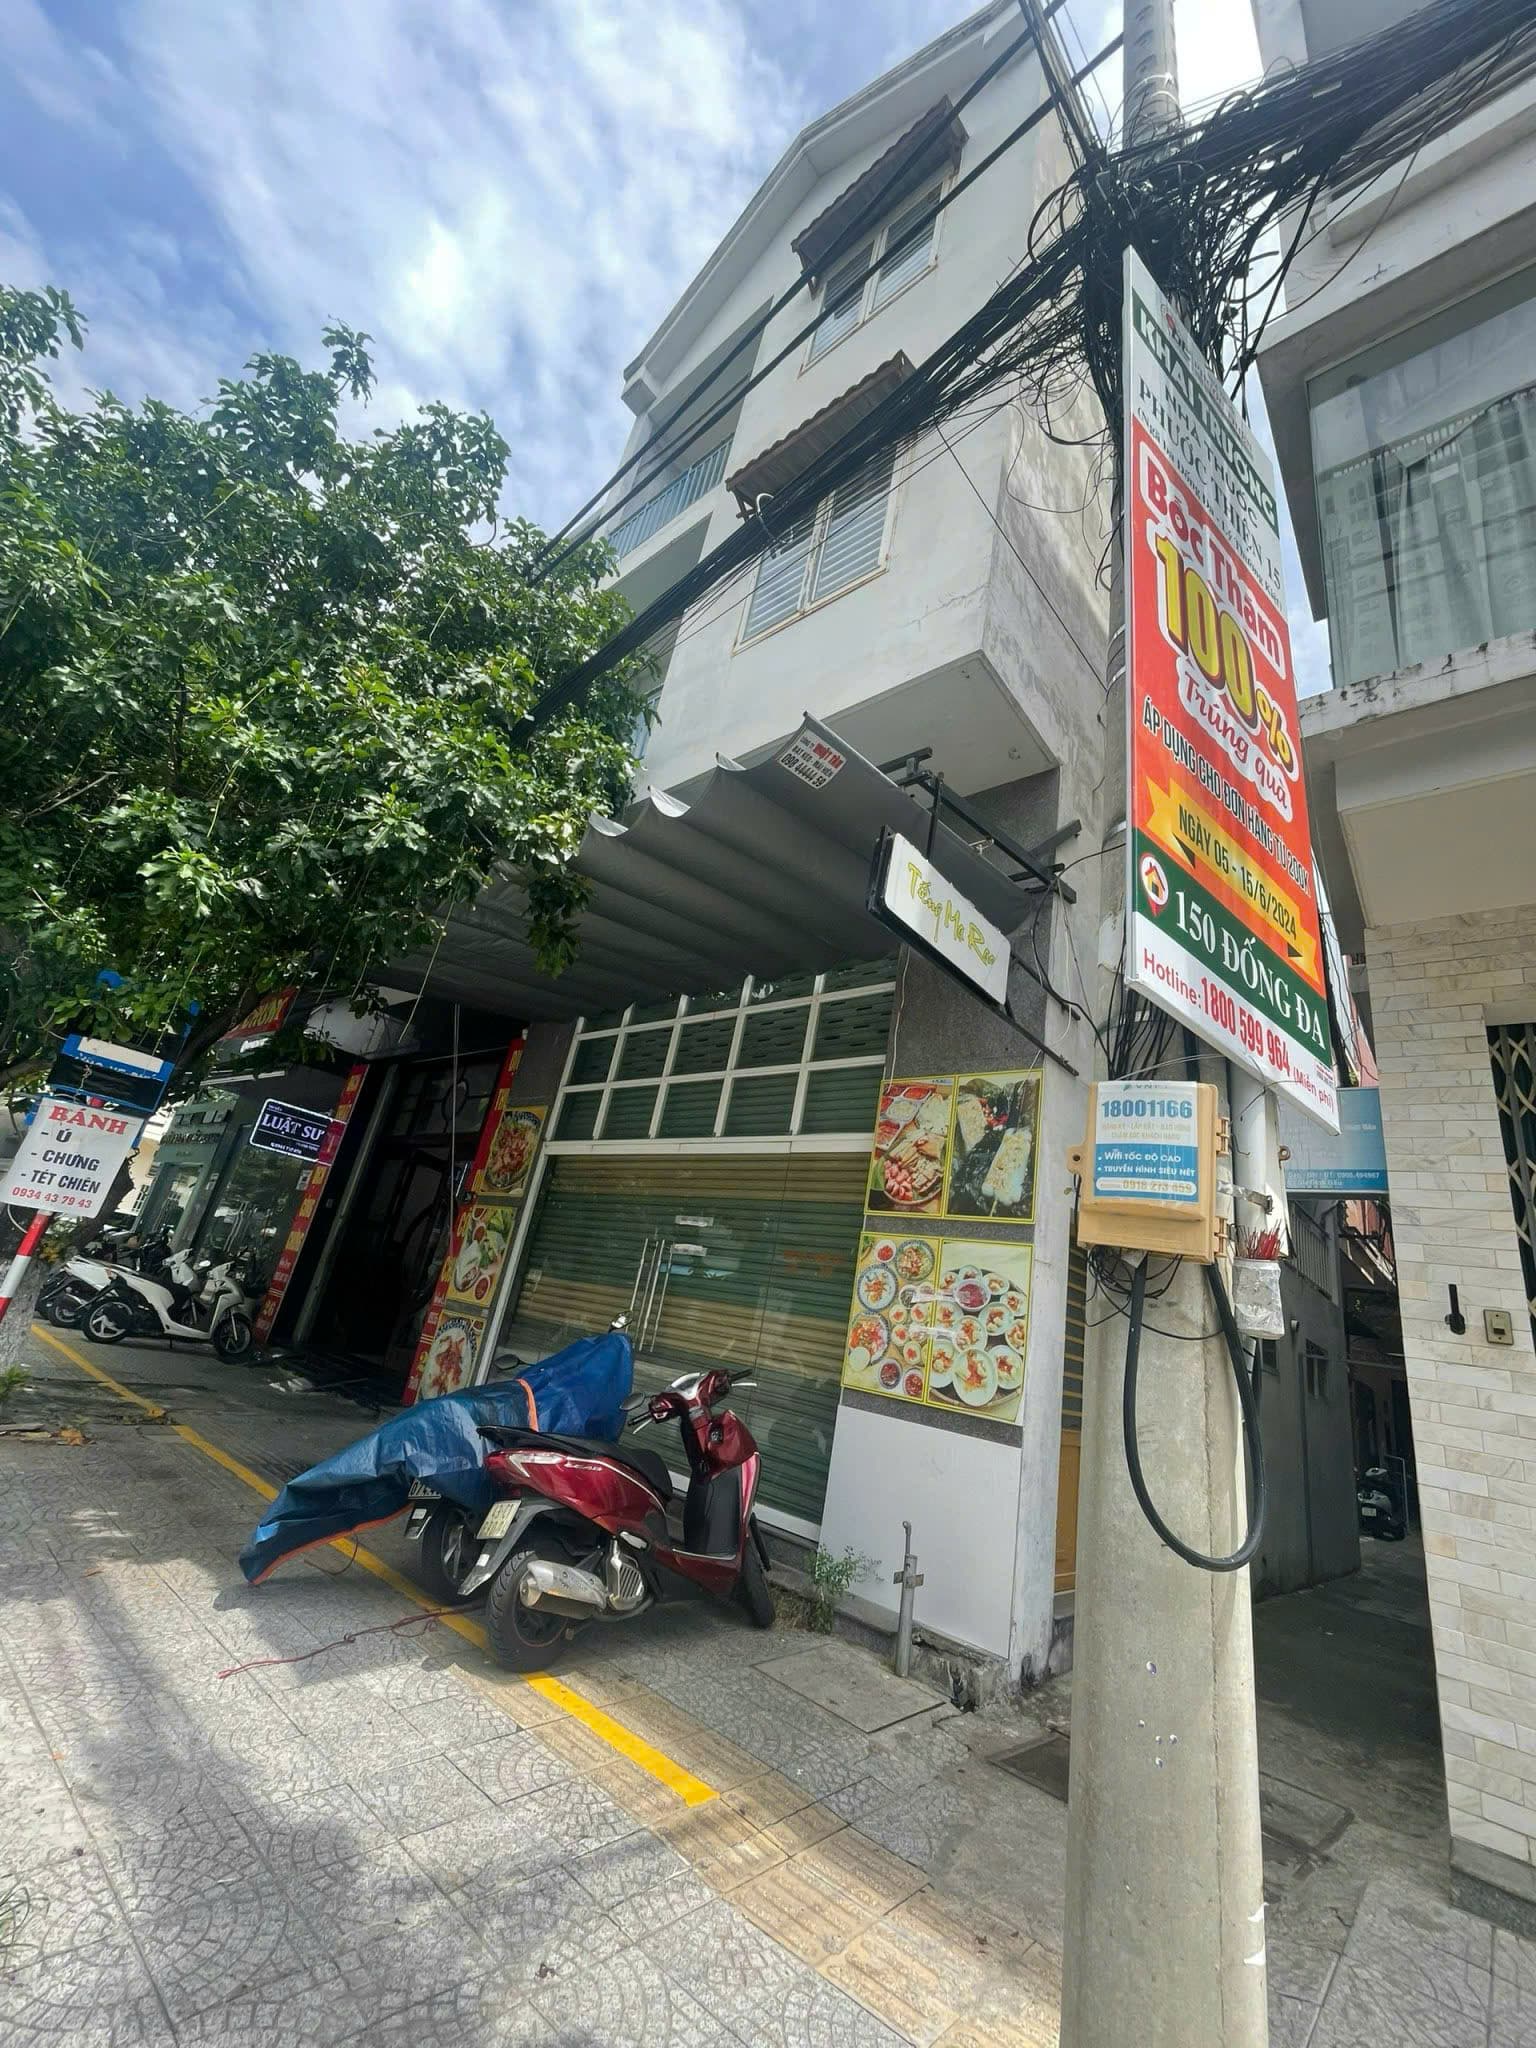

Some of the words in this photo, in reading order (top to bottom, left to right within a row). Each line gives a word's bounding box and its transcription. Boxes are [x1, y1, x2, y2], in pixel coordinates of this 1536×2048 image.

[1140, 309, 1194, 406] KHAI
[1140, 376, 1208, 486] PHƯỚC
[1211, 475, 1263, 566] THIỆN
[1266, 556, 1281, 590] 15
[1165, 385, 1201, 449] NHÀ
[1204, 440, 1258, 529] THUỐC
[1147, 455, 1204, 567] Bốc
[1209, 538, 1280, 668] Thăm
[1155, 537, 1293, 773] 100%
[1144, 697, 1161, 733] ÁP
[1164, 719, 1195, 773] DỤNG
[1199, 757, 1221, 801] CHO
[1223, 780, 1246, 824] ĐƠN
[1247, 806, 1274, 856] HÀNG
[1184, 672, 1249, 764] Trúng
[1254, 755, 1287, 809] quà
[1179, 805, 1211, 857] NGÀY
[1214, 842, 1230, 874] 05
[1240, 867, 1298, 940] 15/6/2024
[1176, 891, 1217, 953] 150
[1221, 927, 1292, 1019] ĐỐNG
[1295, 992, 1326, 1050] ĐA
[1201, 977, 1237, 1036] 1800
[1239, 1006, 1264, 1057] 599
[1267, 1028, 1291, 1077] 964
[48, 1105, 129, 1135] BÁNH
[55, 1128, 73, 1143] Ú
[261, 1113, 302, 1135] LUẬT
[301, 1125, 326, 1141] SƯ
[1101, 1099, 1193, 1119] 18001166
[1104, 1151, 1122, 1160] Wifi
[1145, 1152, 1158, 1162] ĐỘ
[1160, 1154, 1181, 1163] CAO
[12, 1186, 42, 1200] 0934
[44, 1193, 59, 1203] 43
[62, 1195, 75, 1206] 79
[78, 1199, 92, 1208] 43
[42, 1149, 101, 1172] CHƯNG
[1135, 1164, 1156, 1174] HÌNH
[1158, 1165, 1177, 1175] SIÊU
